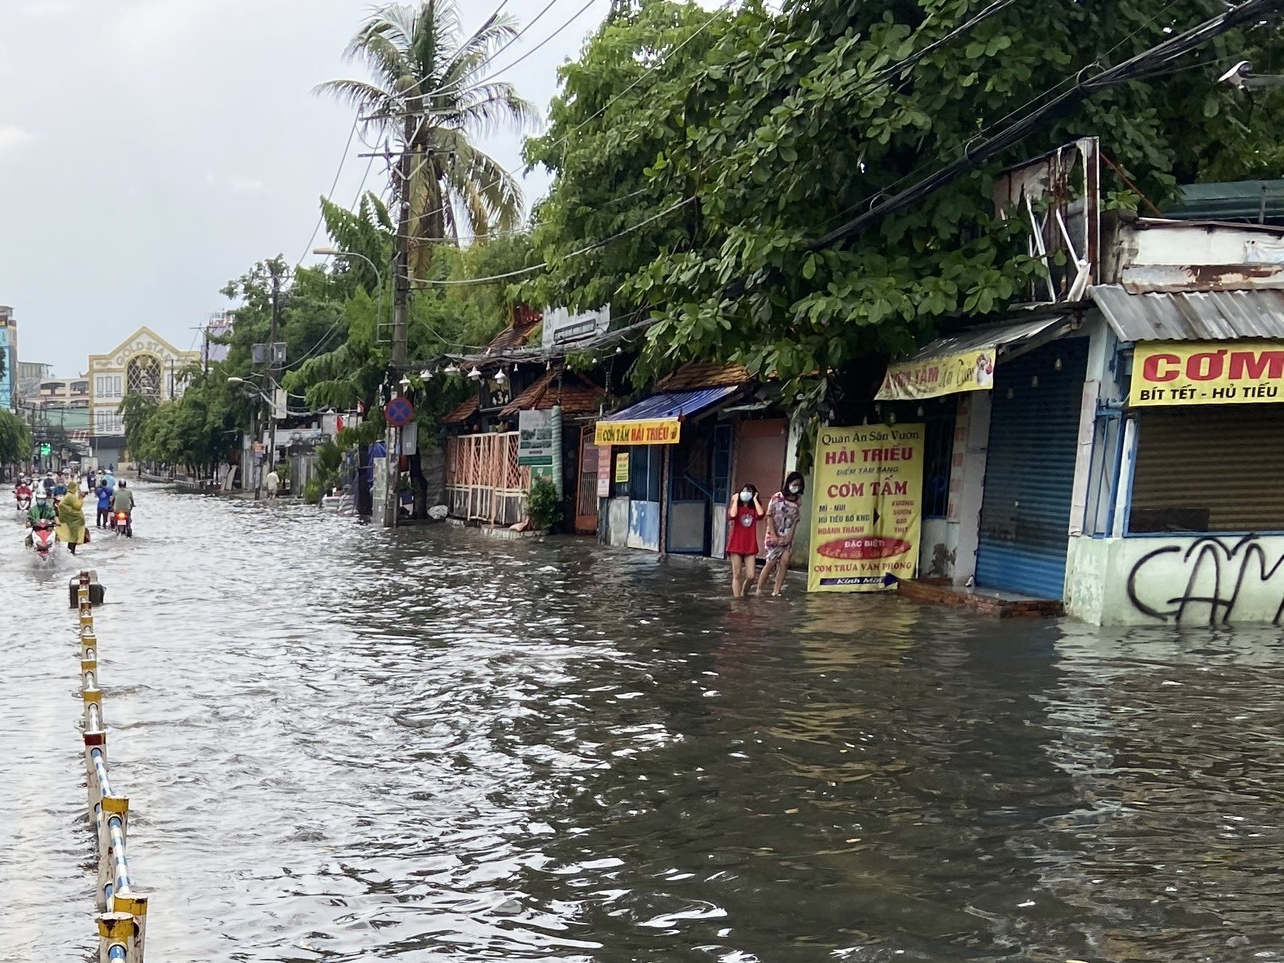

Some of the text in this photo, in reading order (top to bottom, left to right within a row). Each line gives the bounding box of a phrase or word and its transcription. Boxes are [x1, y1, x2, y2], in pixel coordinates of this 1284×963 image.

[116, 341, 145, 366] GOLD
[1143, 349, 1284, 382] CƠM
[1140, 386, 1165, 400] BÍT
[1170, 384, 1196, 399] TẾT
[1212, 384, 1236, 398] HỦ
[1243, 382, 1277, 398] TIẾU
[825, 446, 855, 464] HẢI
[827, 474, 908, 498] CƠM TẤM
